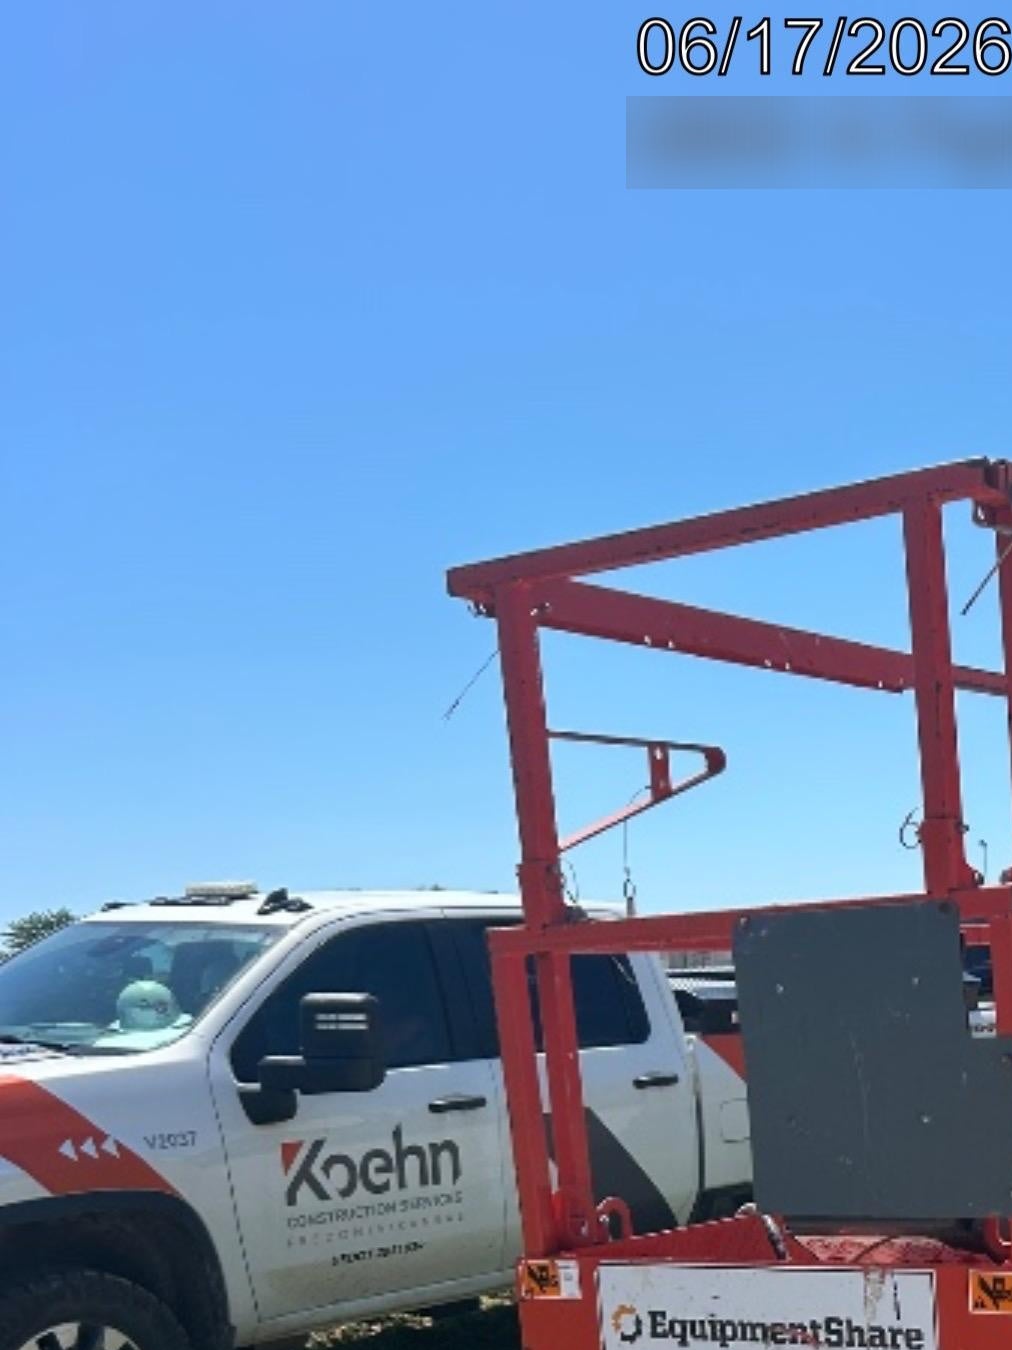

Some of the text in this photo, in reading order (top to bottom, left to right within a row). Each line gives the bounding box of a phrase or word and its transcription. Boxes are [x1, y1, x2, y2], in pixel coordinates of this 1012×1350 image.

[143, 1130, 197, 1150] V2037
[281, 1122, 462, 1207] Koehn
[287, 1201, 397, 1230] CONSTRUCTION
[647, 1310, 925, 1350] EquipmentShare
